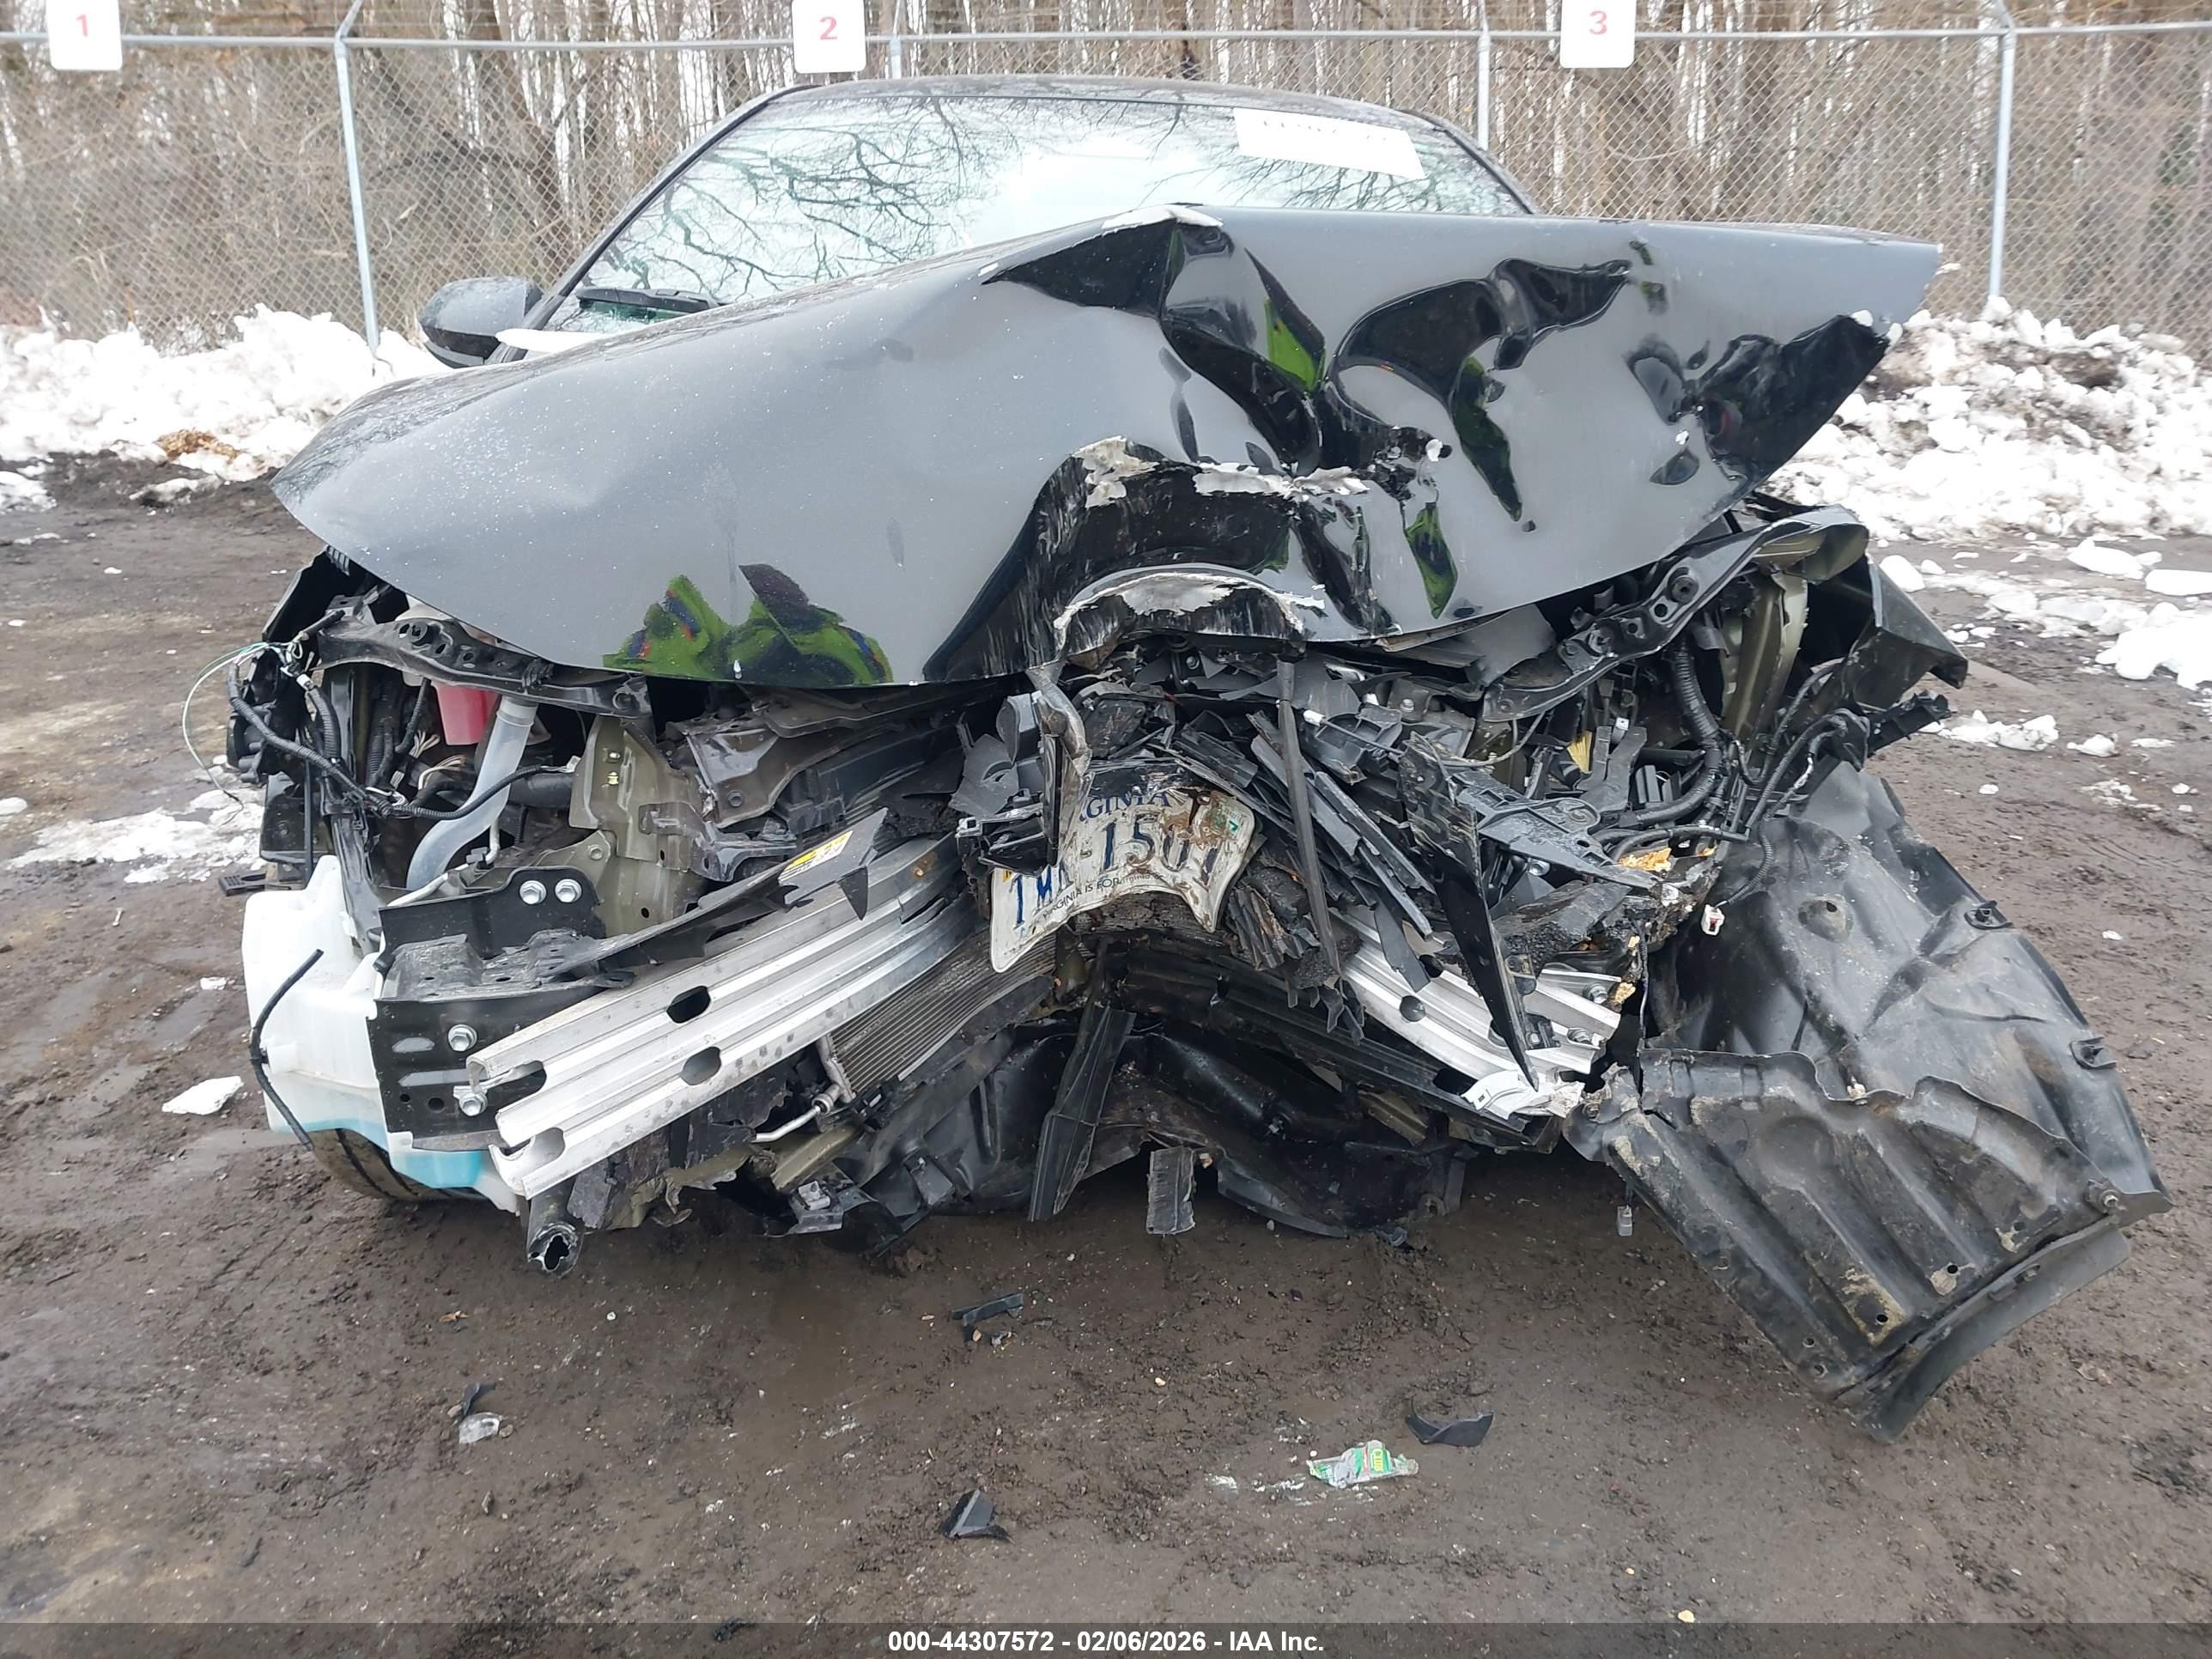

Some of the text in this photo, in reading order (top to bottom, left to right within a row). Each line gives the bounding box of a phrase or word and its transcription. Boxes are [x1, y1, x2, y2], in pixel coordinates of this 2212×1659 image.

[76, 14, 88, 37] 1
[819, 16, 837, 40] 2
[1589, 10, 1607, 35] 3
[1079, 792, 1172, 822] GINIA
